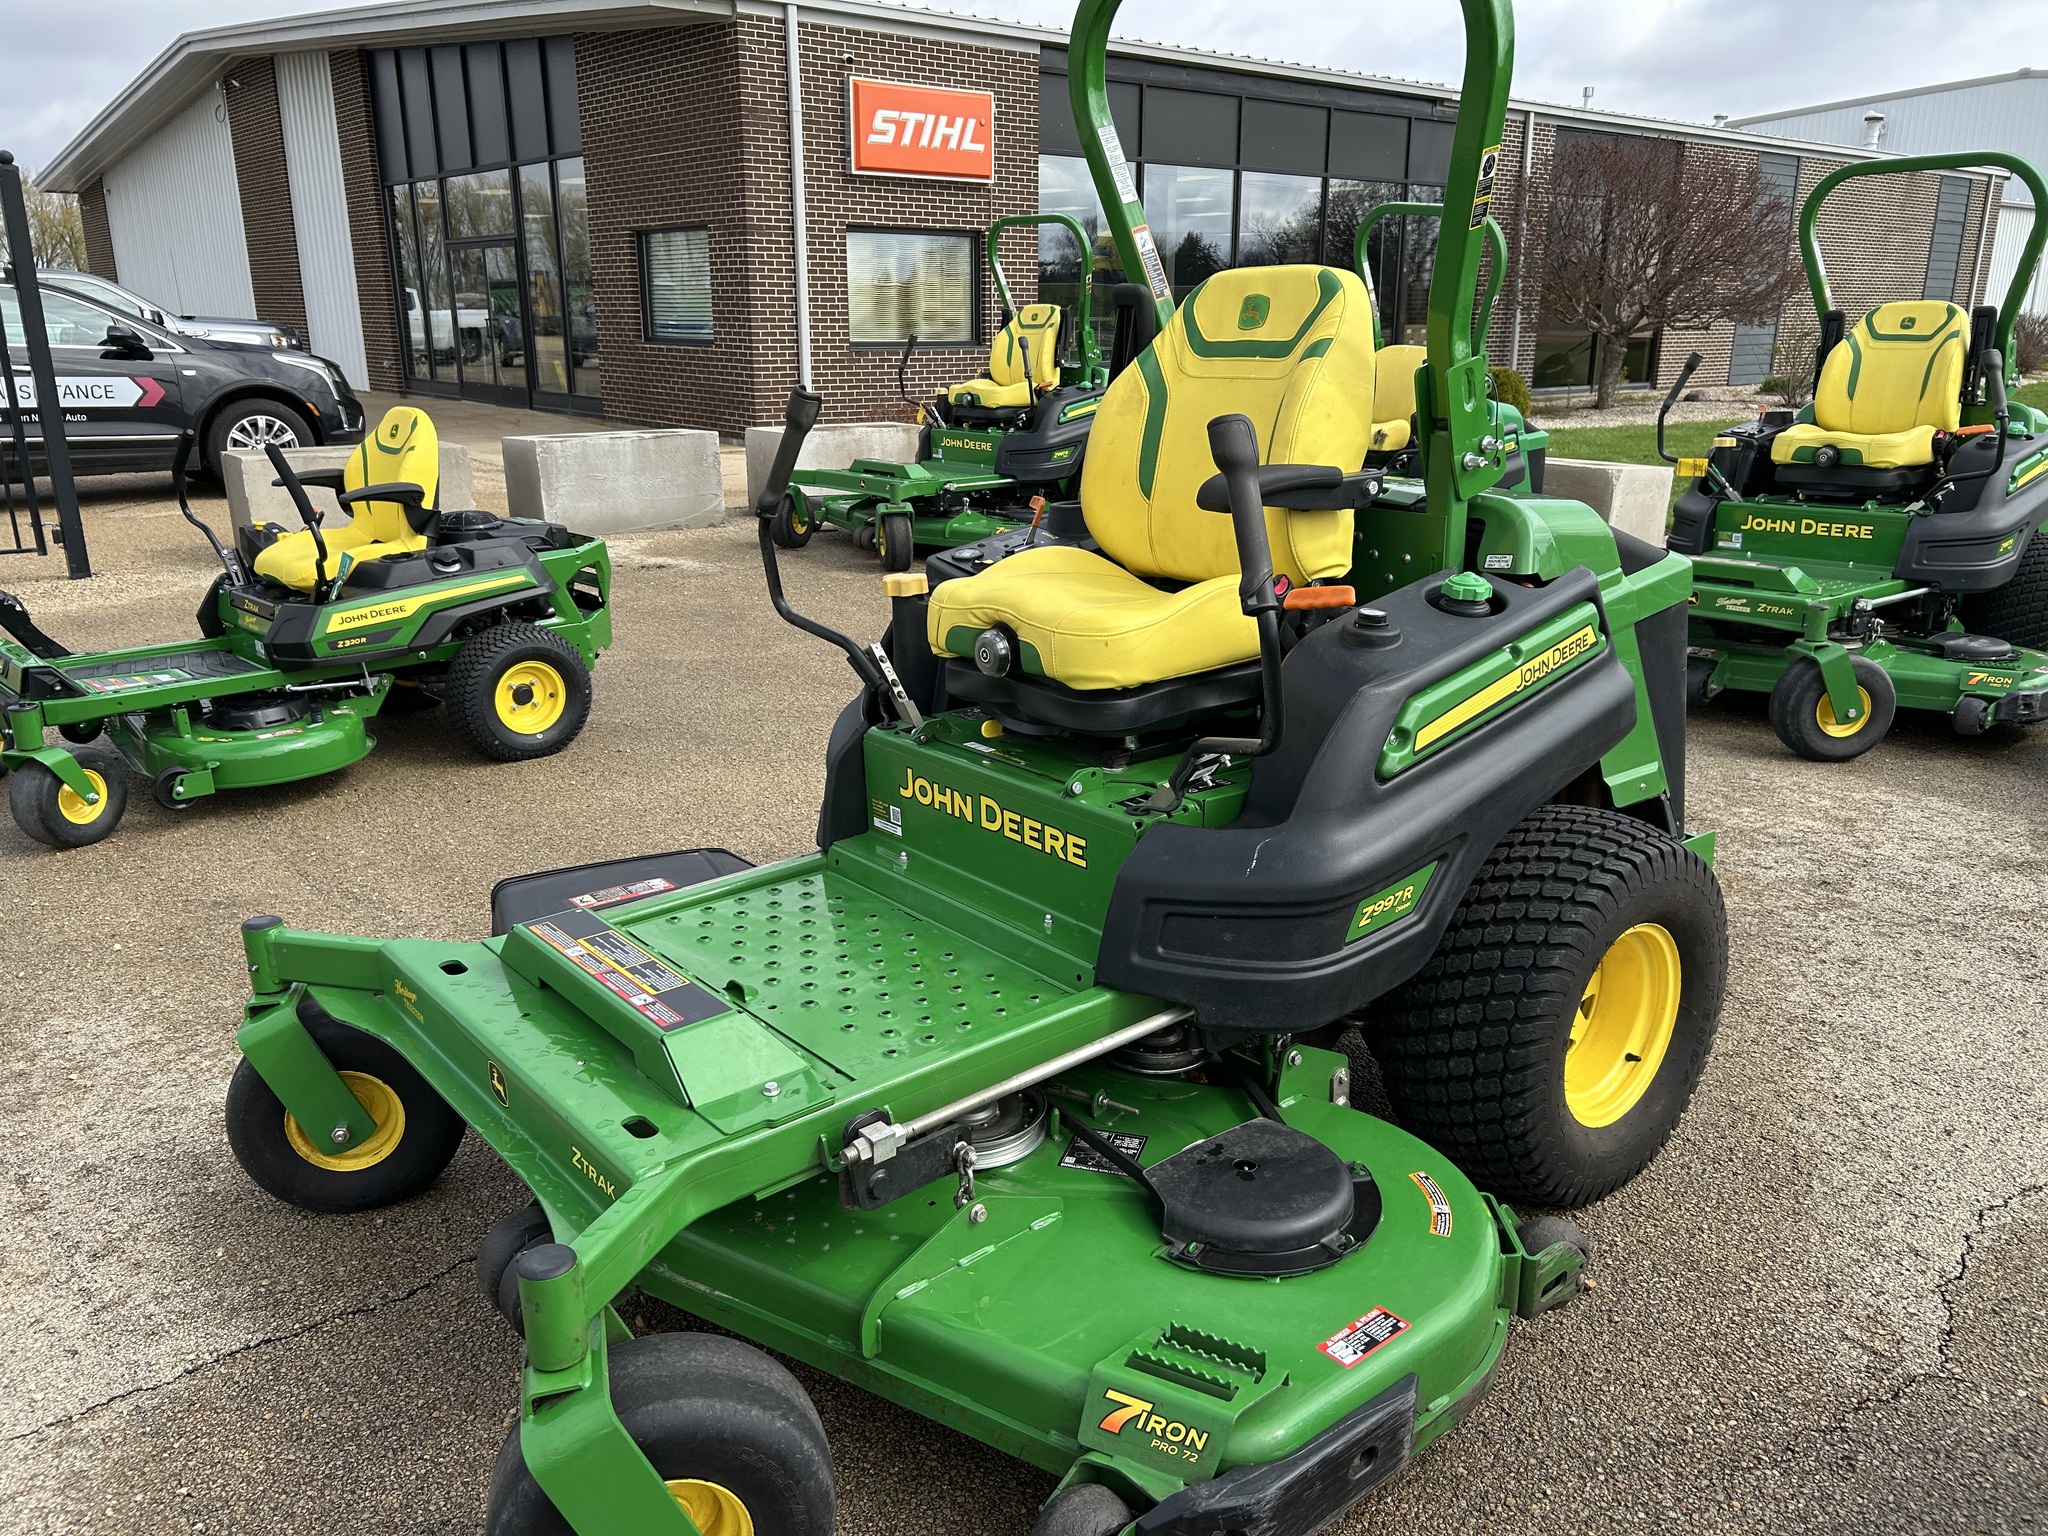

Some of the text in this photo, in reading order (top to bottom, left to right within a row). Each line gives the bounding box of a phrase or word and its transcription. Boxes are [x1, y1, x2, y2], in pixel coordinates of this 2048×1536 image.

[867, 109, 985, 153] STIHL
[65, 414, 87, 422] Auto
[940, 437, 992, 451] JOHN DEERE
[1740, 514, 1874, 539] JOHN DEERE
[338, 605, 407, 625] JOHN DEERE
[1757, 603, 1794, 615] ZTRAK
[337, 637, 367, 648] Z320R
[1517, 632, 1590, 690] JOHN DEERE
[900, 767, 1088, 869] JOHN DEERE
[1357, 885, 1415, 929] Z997R
[570, 1146, 617, 1201] ZTRAK
[1150, 1439, 1199, 1463] PRO 72
